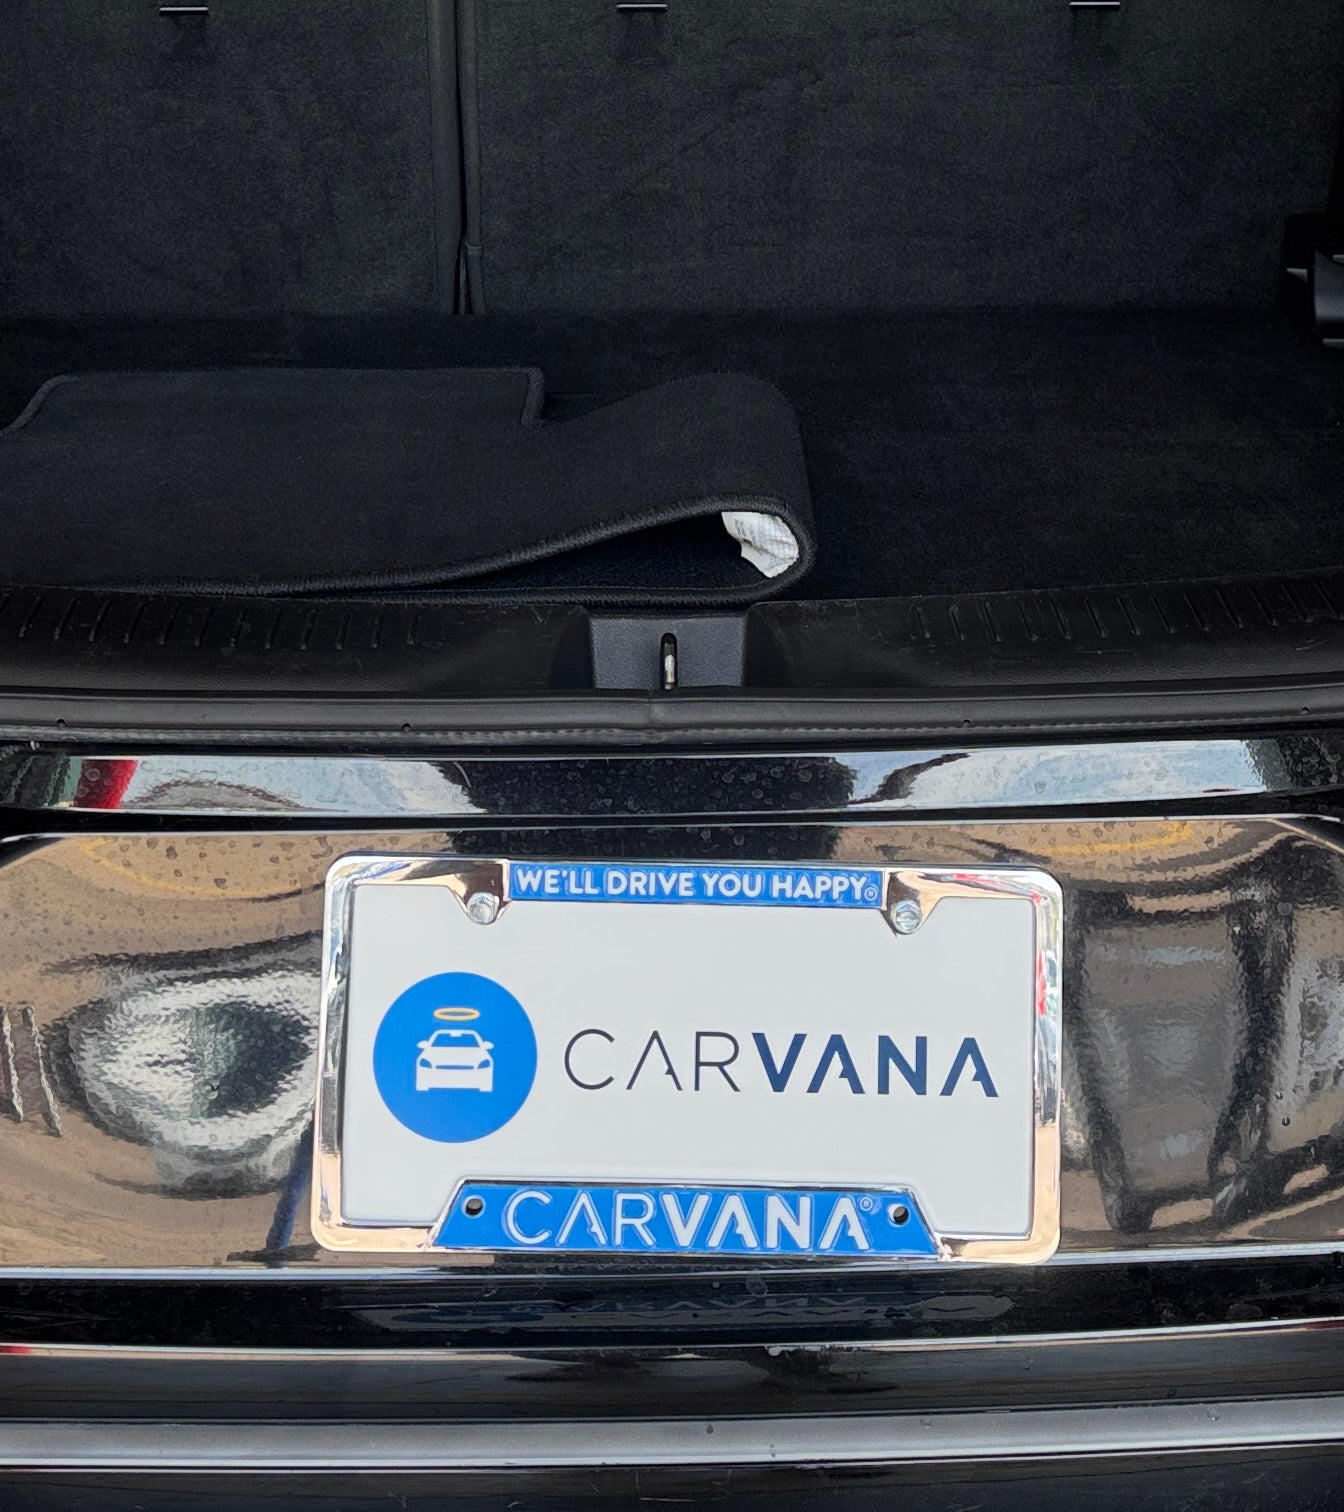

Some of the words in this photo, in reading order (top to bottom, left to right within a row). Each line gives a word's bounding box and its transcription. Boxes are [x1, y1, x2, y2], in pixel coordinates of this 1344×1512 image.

[516, 868, 600, 895] WE'LL
[607, 870, 694, 896] DRIVE
[702, 872, 762, 898] YOU
[563, 1027, 1000, 1098] CARVANA
